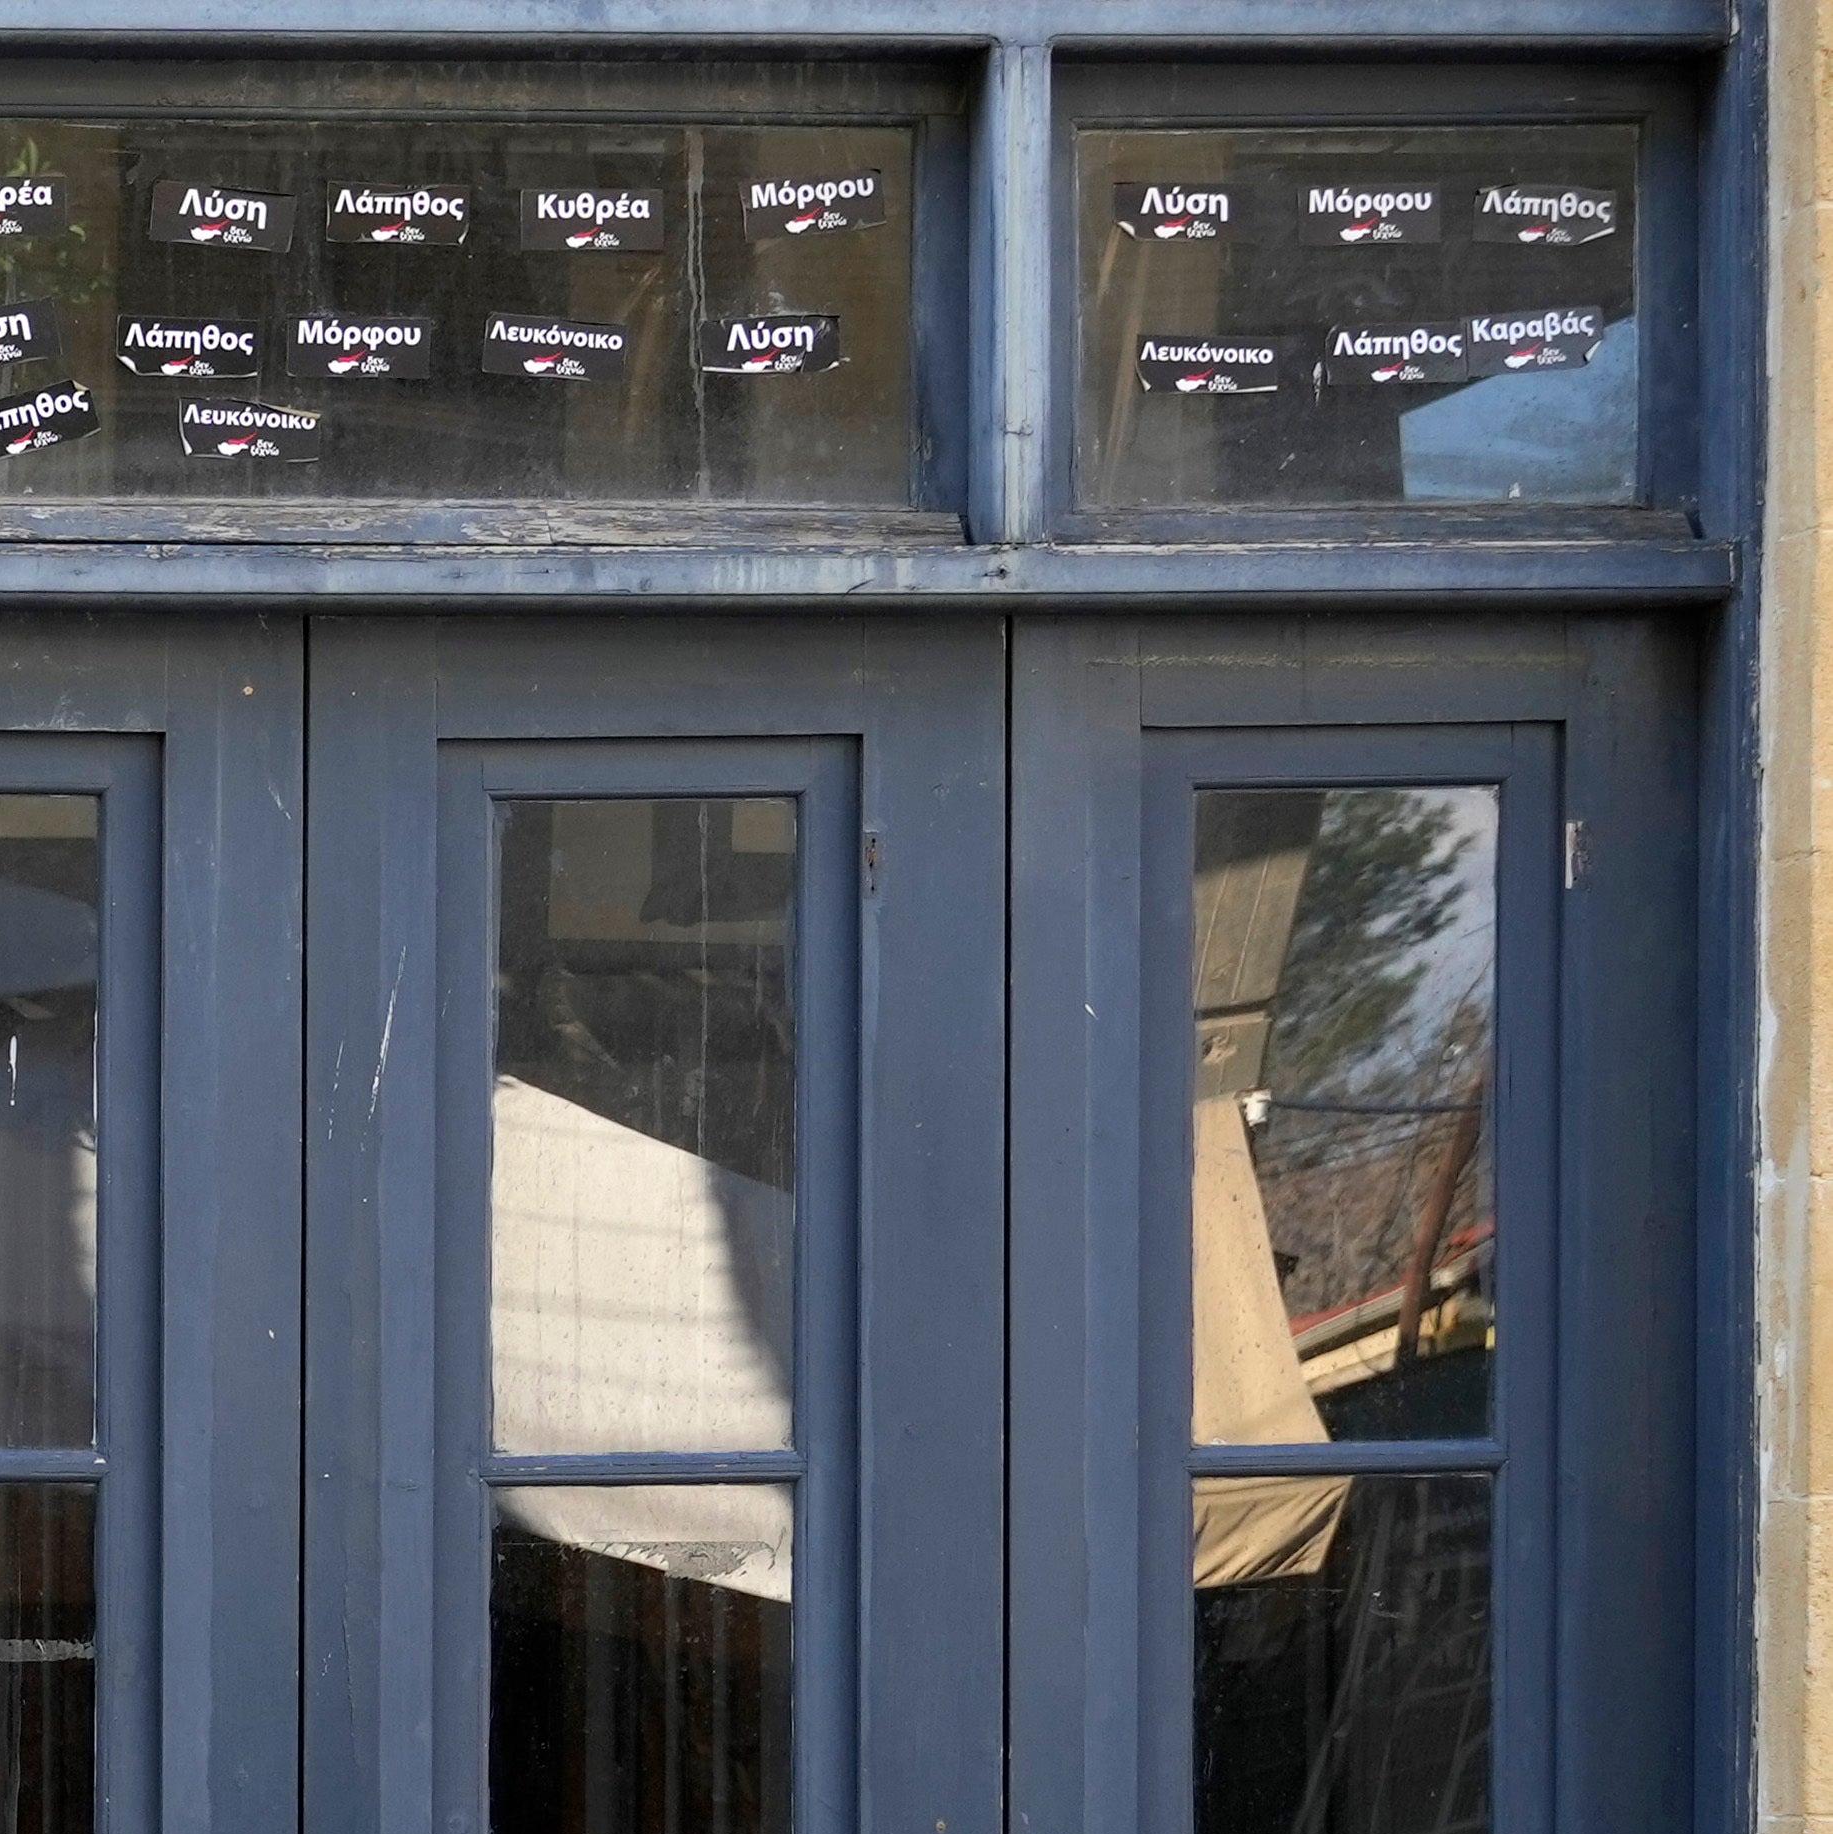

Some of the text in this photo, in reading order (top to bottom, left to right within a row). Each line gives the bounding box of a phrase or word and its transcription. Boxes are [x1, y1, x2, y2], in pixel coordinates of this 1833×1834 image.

[179, 187, 267, 229] Λύση
[335, 190, 463, 220] Λάπηθος
[537, 193, 650, 224] Κυθρέα
[751, 178, 874, 209] Μόρφου
[1140, 186, 1228, 221] Λύση
[1309, 188, 1431, 218] Μόρφου
[1483, 190, 1611, 222] Λάπηθος
[125, 323, 253, 355] Λάπηθος
[297, 320, 421, 350] Μόρφου
[490, 320, 622, 350] Λευκόνοικο
[727, 322, 813, 352] Λύση
[1472, 311, 1594, 344] Καραβάς
[1141, 341, 1273, 364] Λευκόνοικο
[1333, 329, 1462, 360] Λάπηθος
